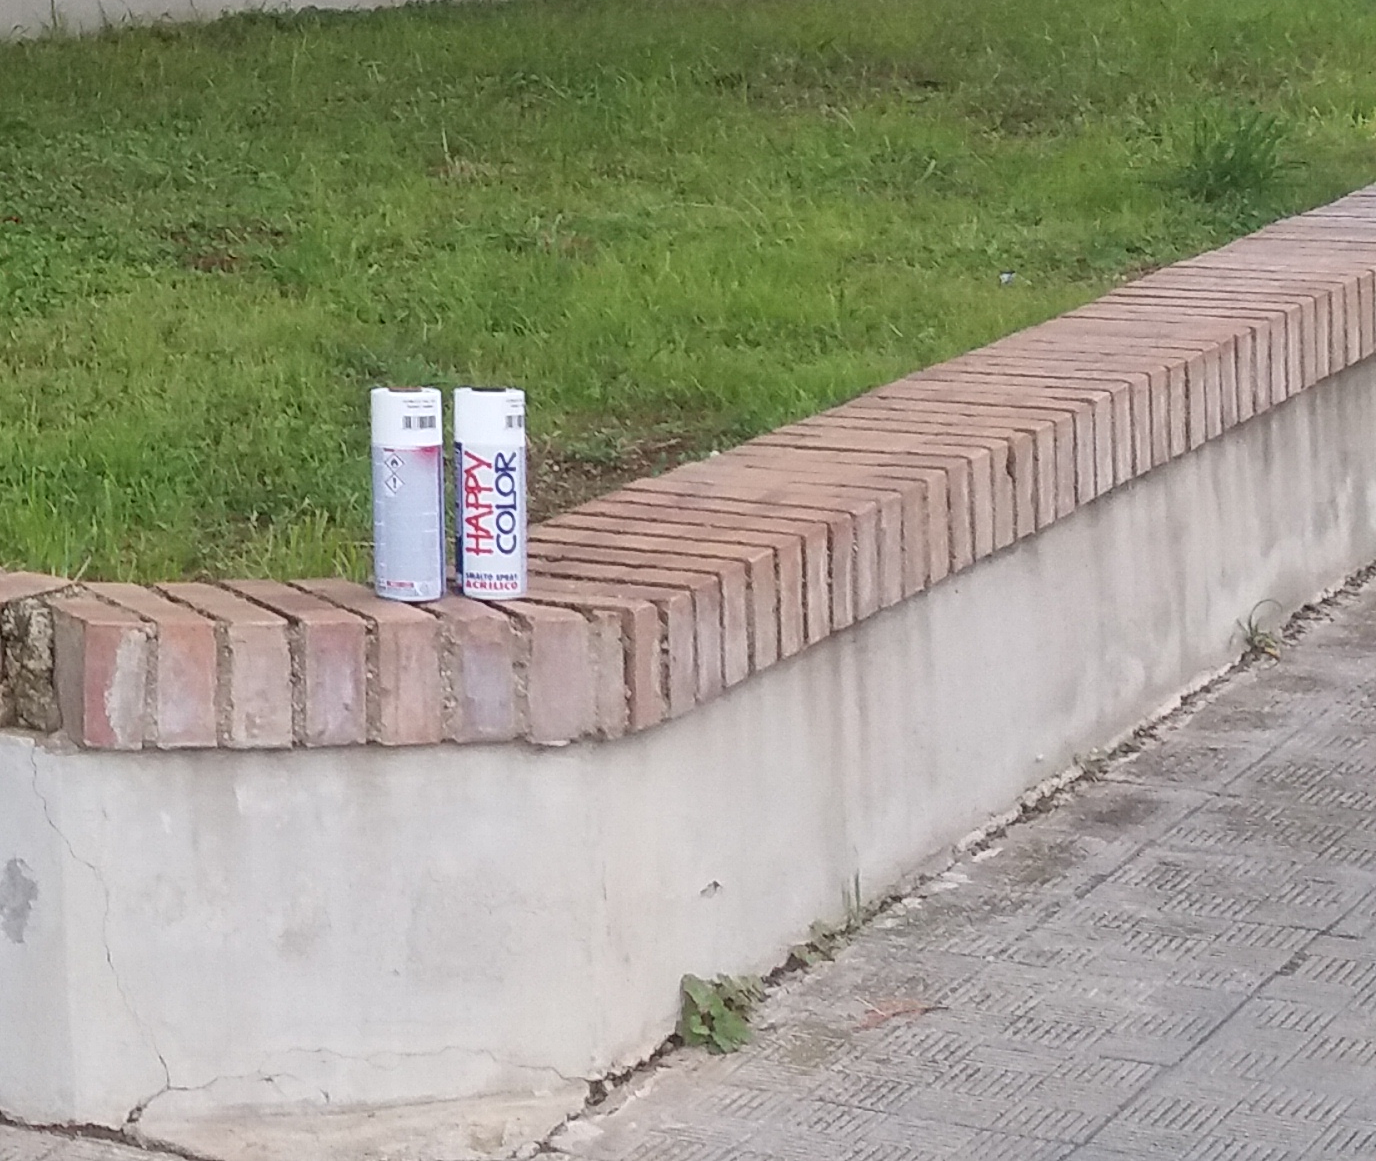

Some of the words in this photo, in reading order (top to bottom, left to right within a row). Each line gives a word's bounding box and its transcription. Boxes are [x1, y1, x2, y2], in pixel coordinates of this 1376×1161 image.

[463, 450, 495, 556] HAPPY
[494, 451, 518, 555] COLOR
[465, 580, 518, 590] ACRILICO
